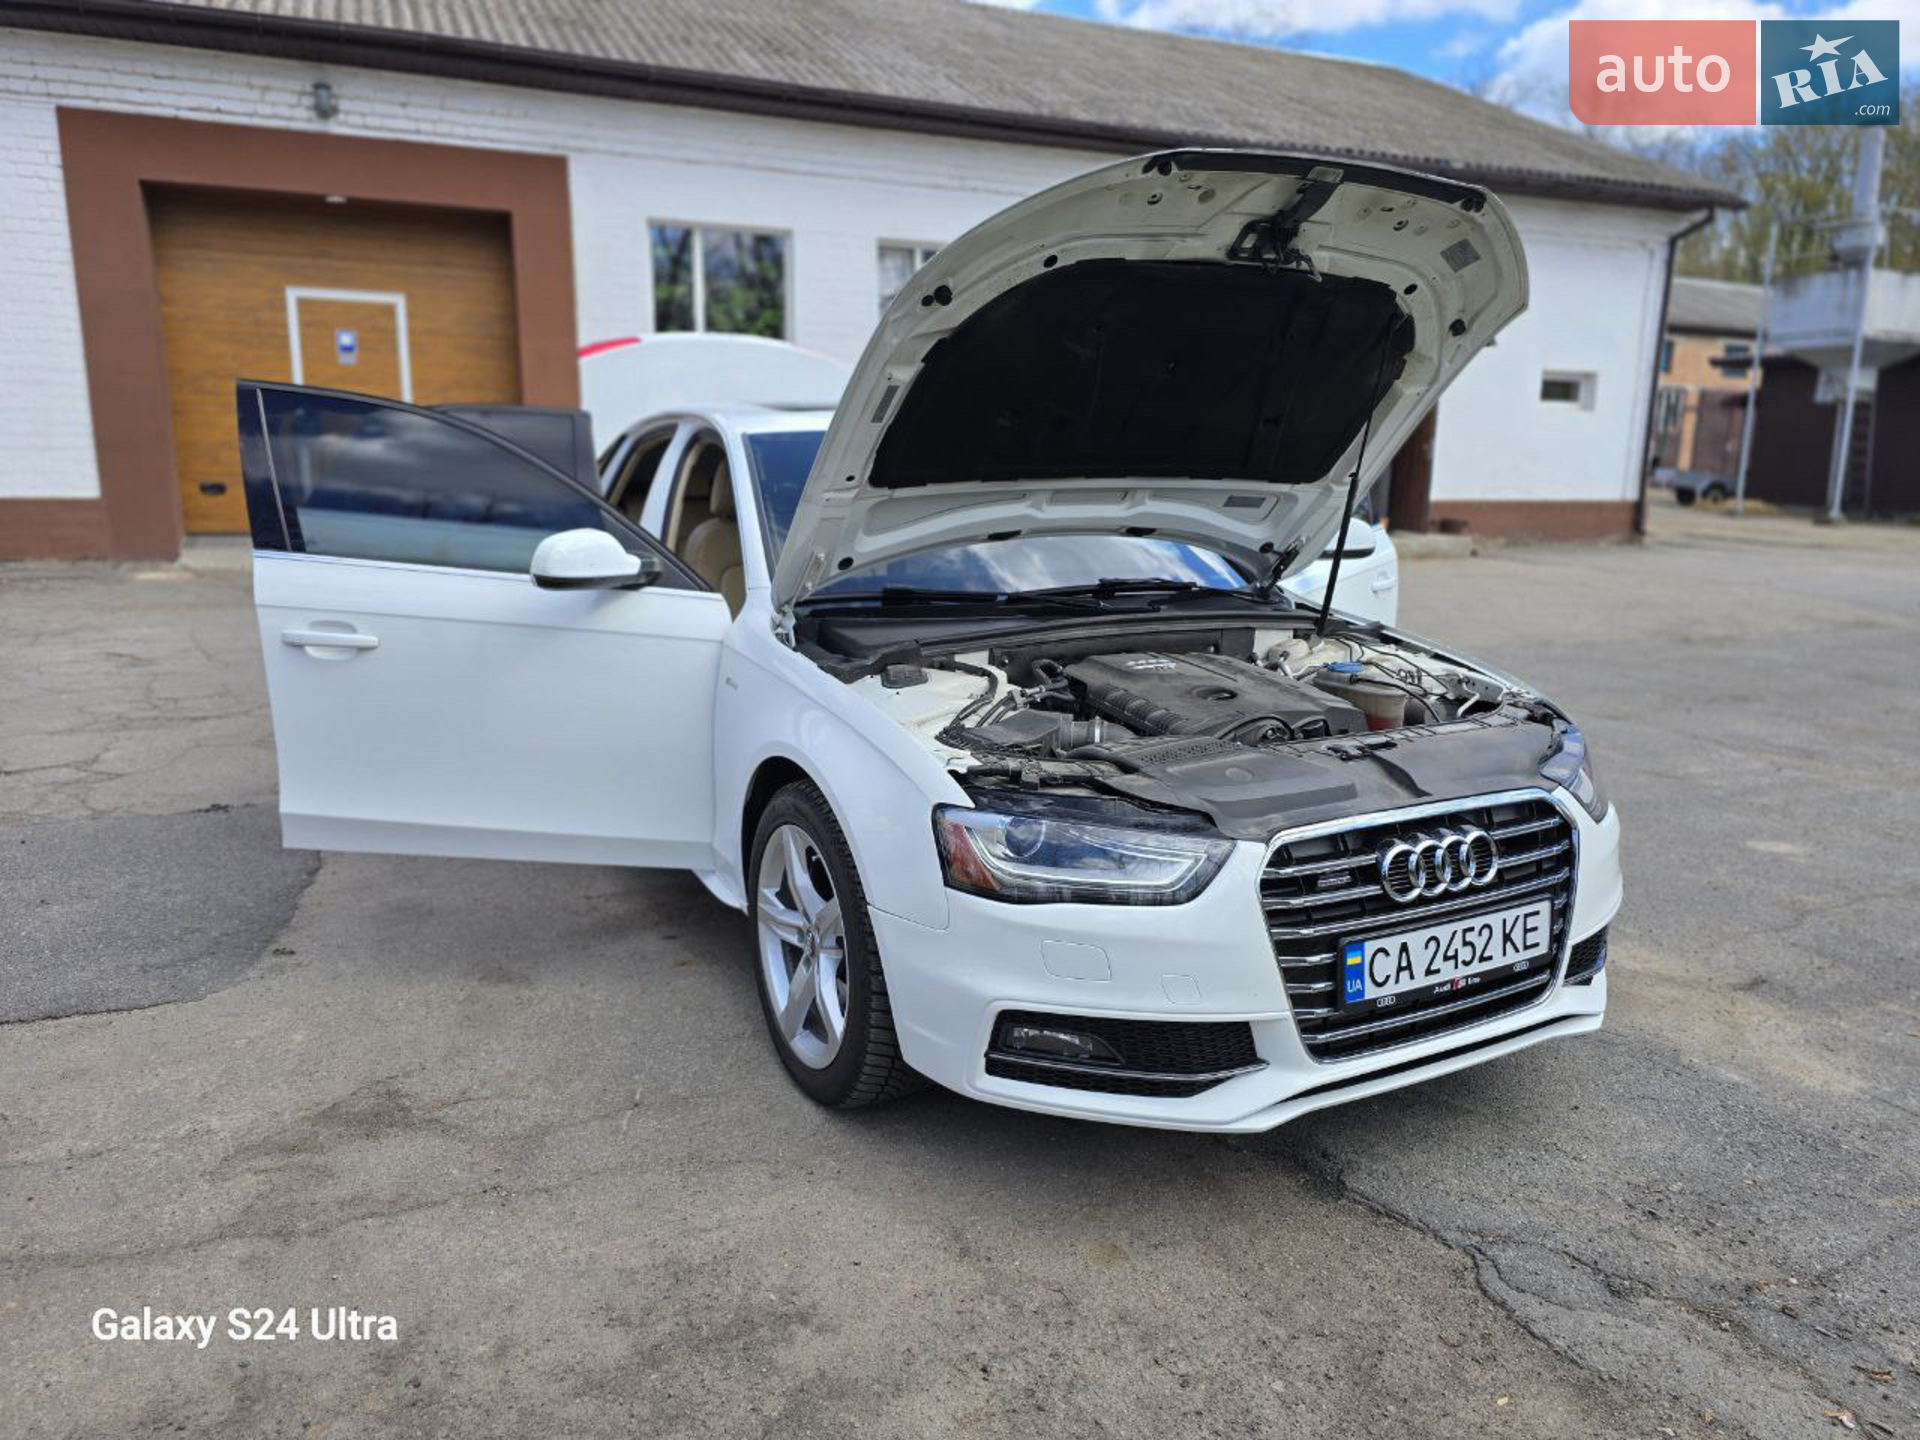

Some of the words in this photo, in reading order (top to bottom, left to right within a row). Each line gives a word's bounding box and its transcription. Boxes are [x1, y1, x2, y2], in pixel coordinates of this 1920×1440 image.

[1368, 941, 1415, 988] CA
[1424, 923, 1494, 977] 2452
[1502, 910, 1541, 958] KE
[1346, 978, 1363, 993] UA
